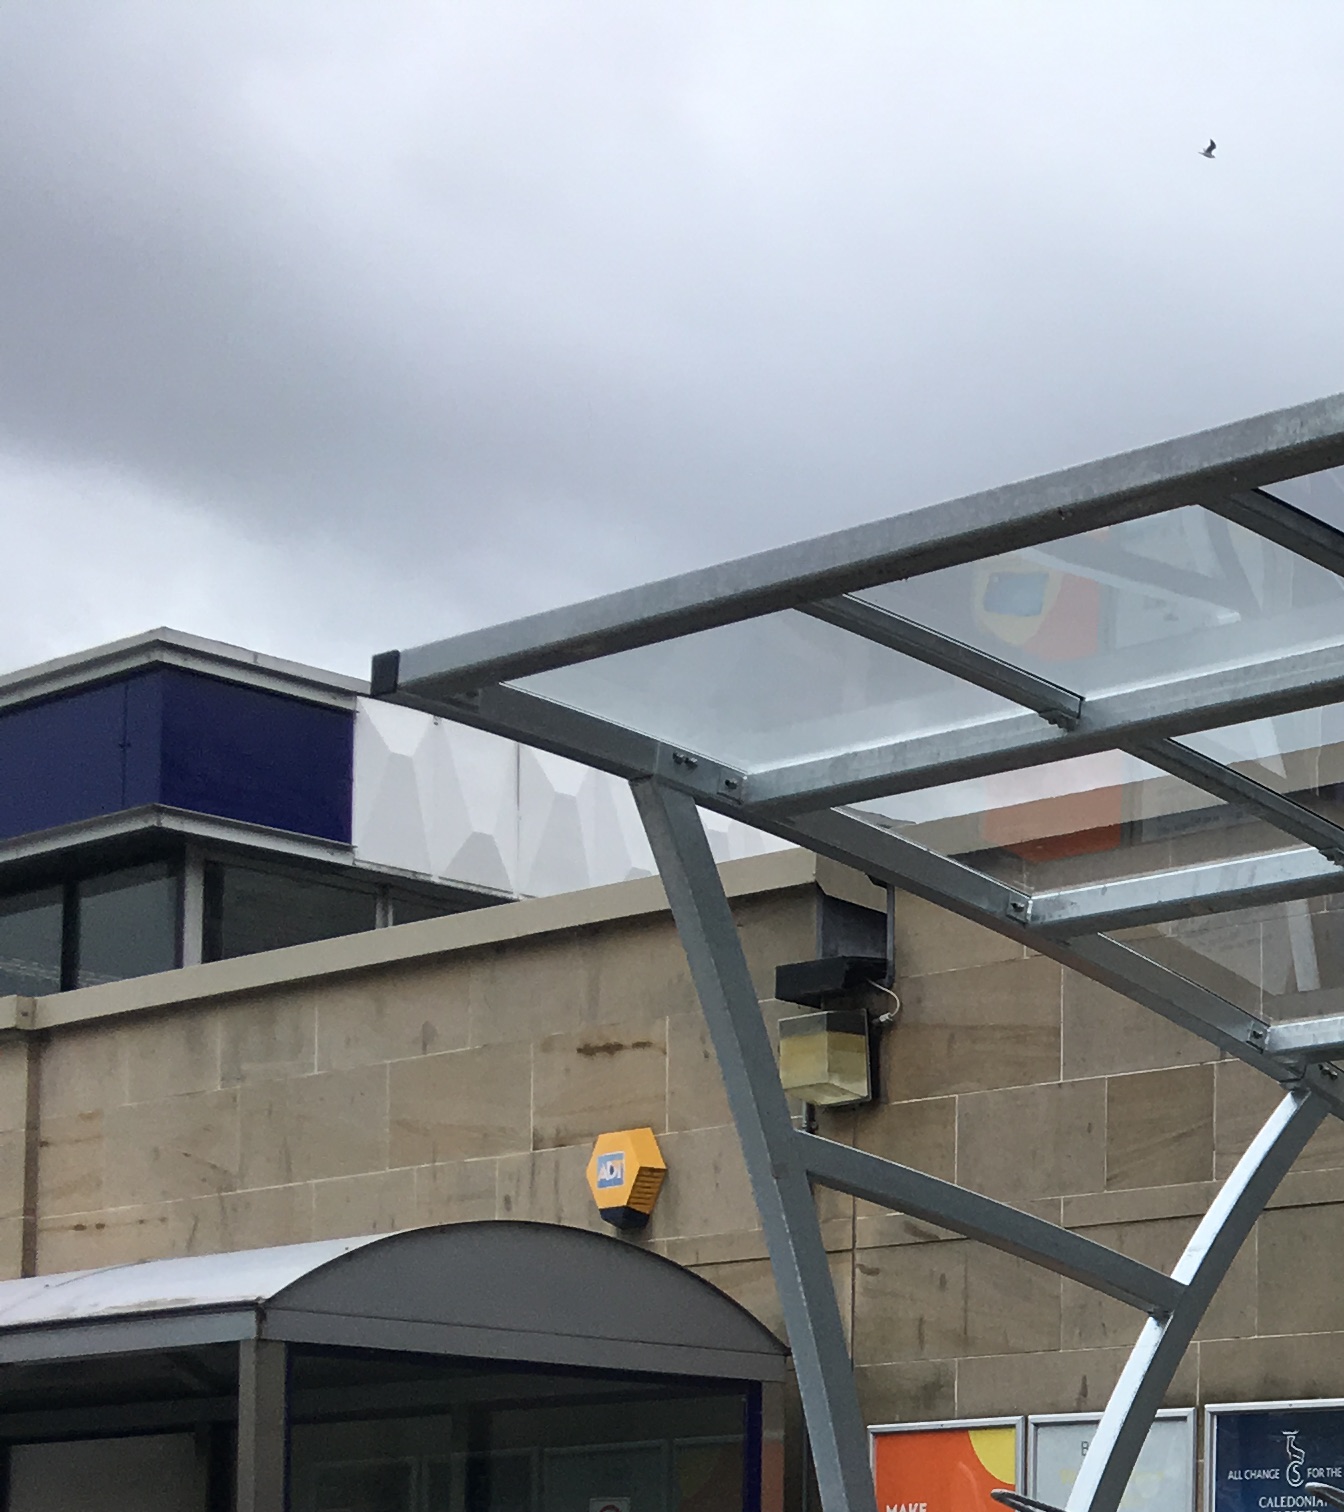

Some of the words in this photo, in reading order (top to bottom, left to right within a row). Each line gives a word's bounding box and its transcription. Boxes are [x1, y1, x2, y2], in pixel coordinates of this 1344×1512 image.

[599, 1161, 622, 1181] ADT
[1228, 1470, 1243, 1480] ALL
[1244, 1469, 1280, 1480] CHANGE
[1307, 1468, 1325, 1478] FOR
[1326, 1467, 1342, 1477] THE
[1258, 1496, 1328, 1508] CALEDONIA
